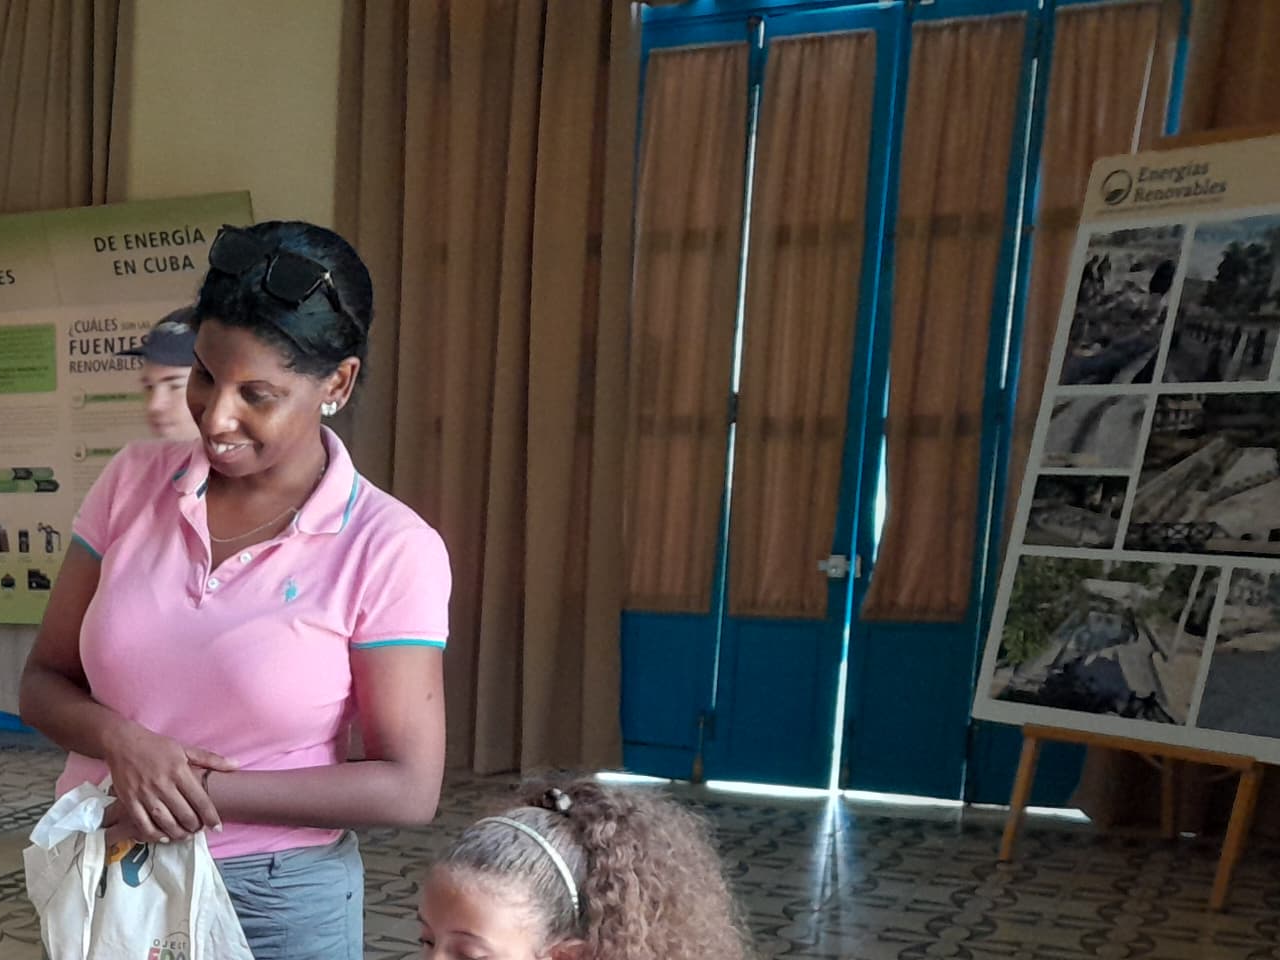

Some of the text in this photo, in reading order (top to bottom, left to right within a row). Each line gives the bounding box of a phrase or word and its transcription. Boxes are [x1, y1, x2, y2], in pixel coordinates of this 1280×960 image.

[94, 224, 206, 253] DE ENERGÍA
[113, 254, 195, 277] EN CUBA
[69, 356, 145, 374] RENOVABLES
